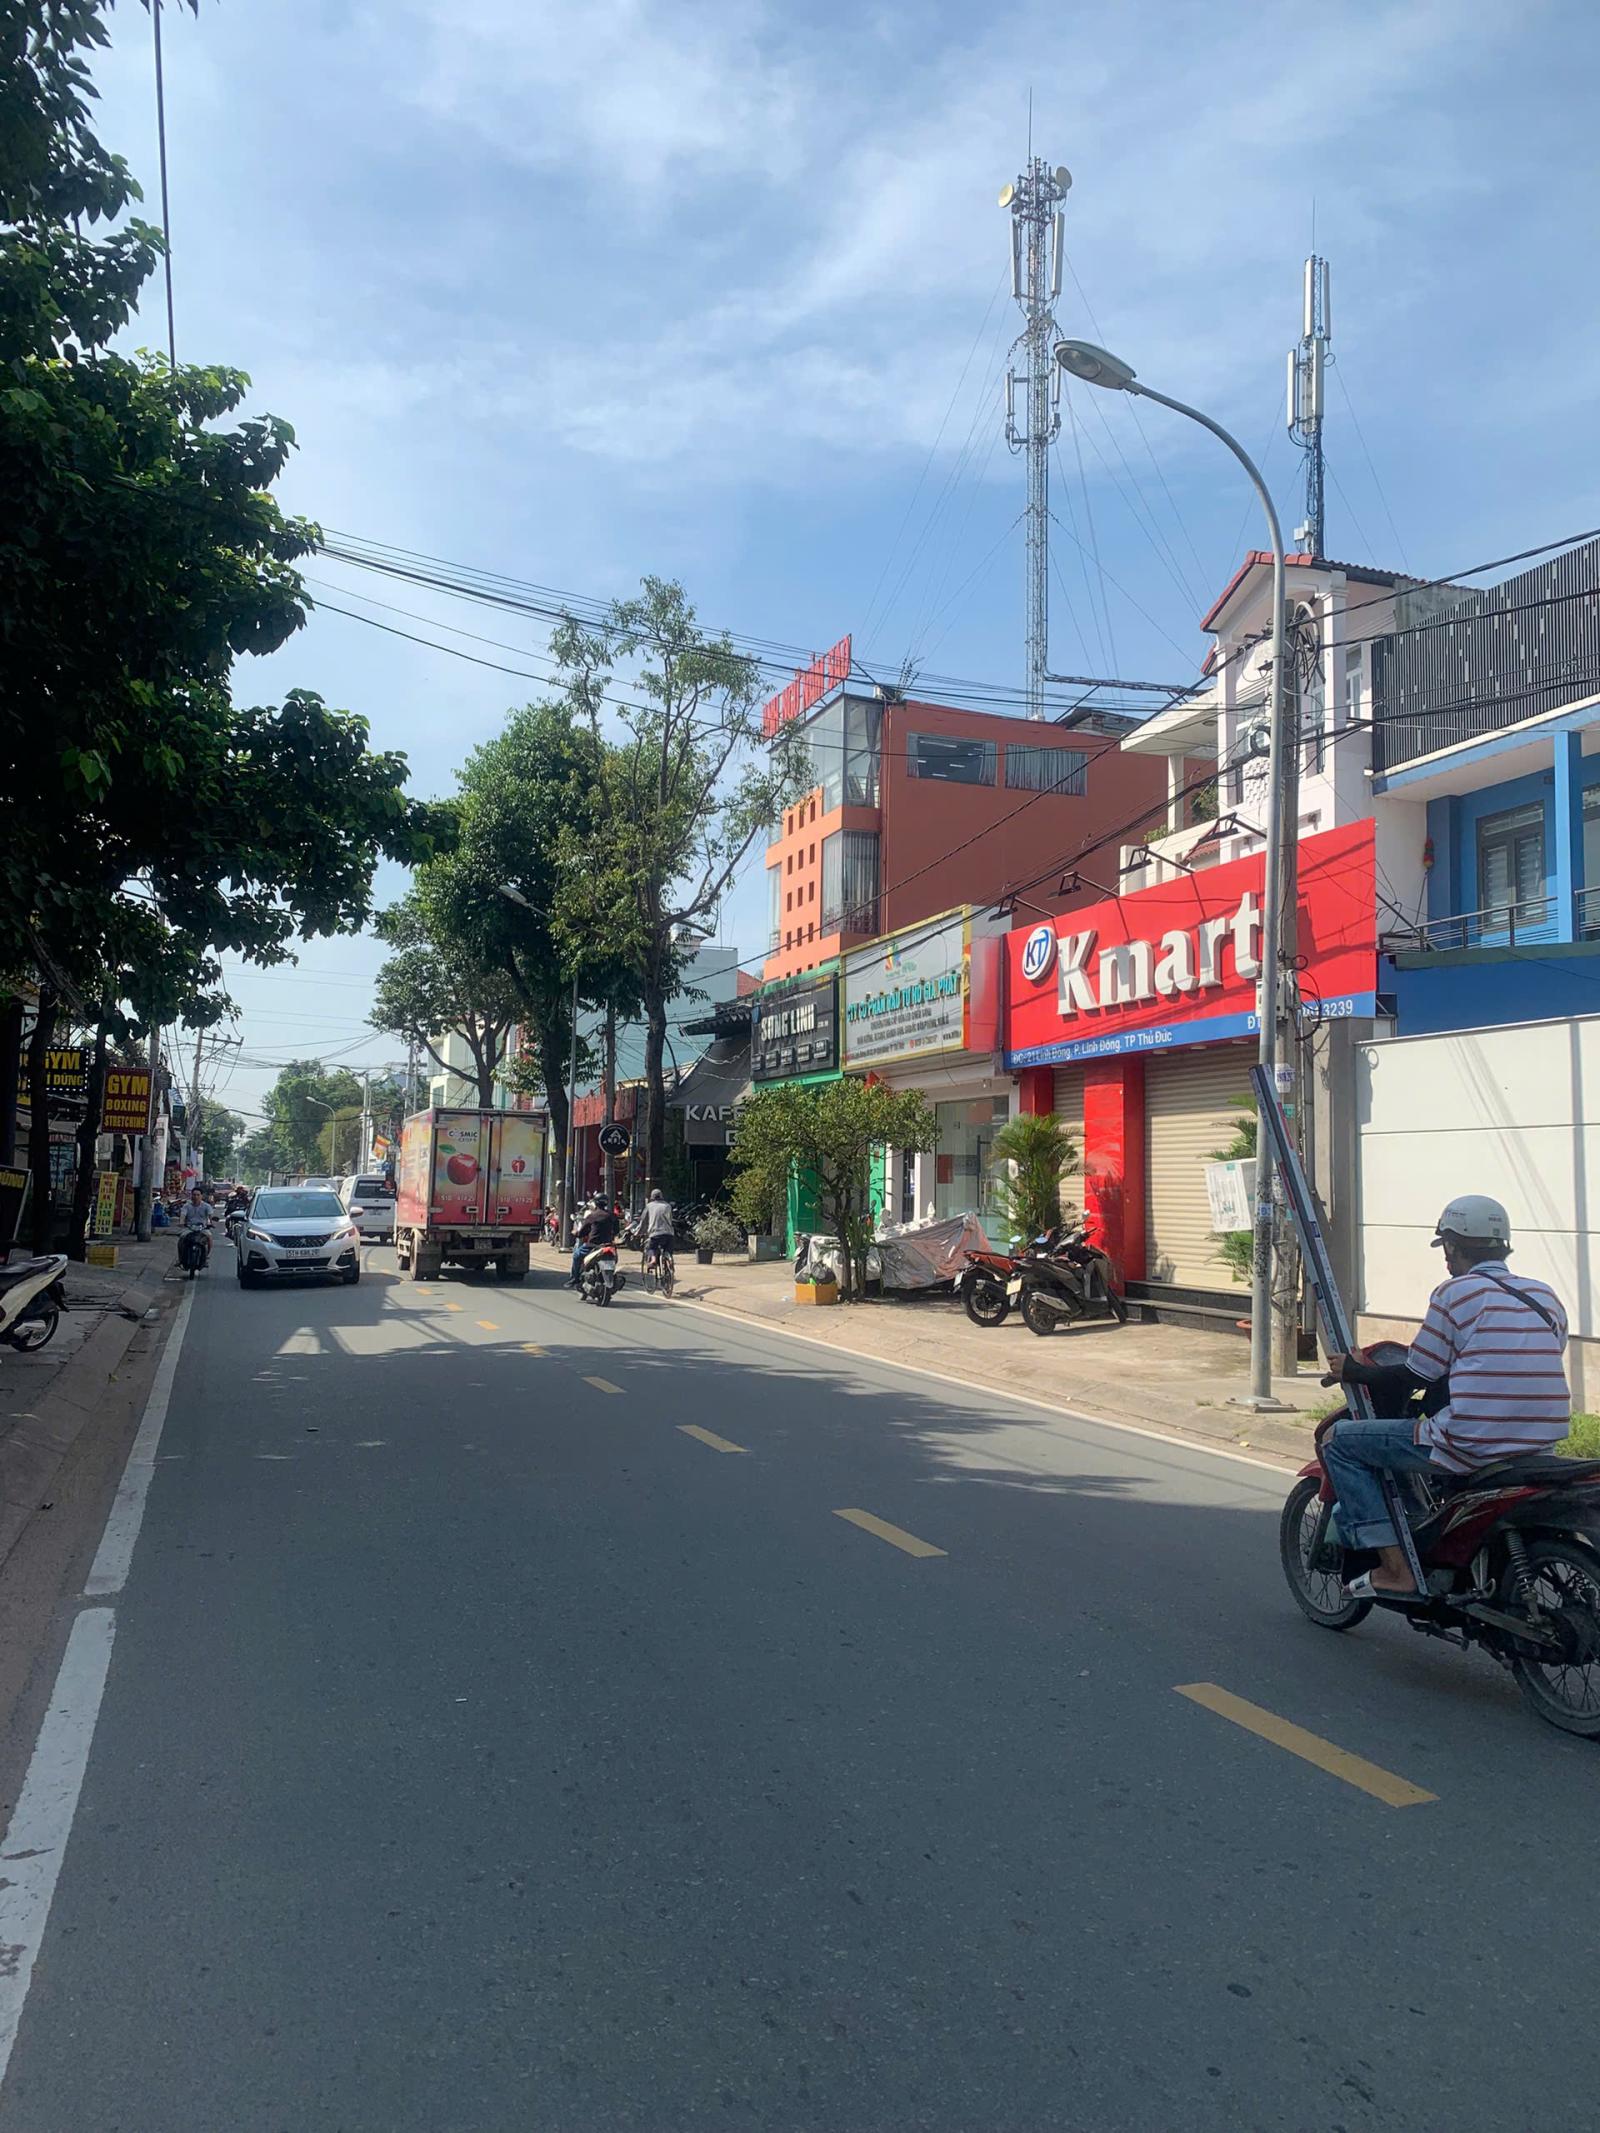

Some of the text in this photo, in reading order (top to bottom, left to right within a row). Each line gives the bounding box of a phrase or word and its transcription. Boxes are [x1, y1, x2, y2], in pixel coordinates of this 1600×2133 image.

[1026, 937, 1048, 969] KT
[1057, 891, 1260, 1016] Kmart
[1322, 1000, 1353, 1017] 3239
[761, 1003, 815, 1041] SONG LINH
[1082, 1041, 1098, 1054] Linh
[1124, 1034, 1136, 1047] TP
[1155, 1028, 1173, 1044] Đức
[107, 1074, 149, 1096] GYM
[105, 1098, 147, 1113] BOXING
